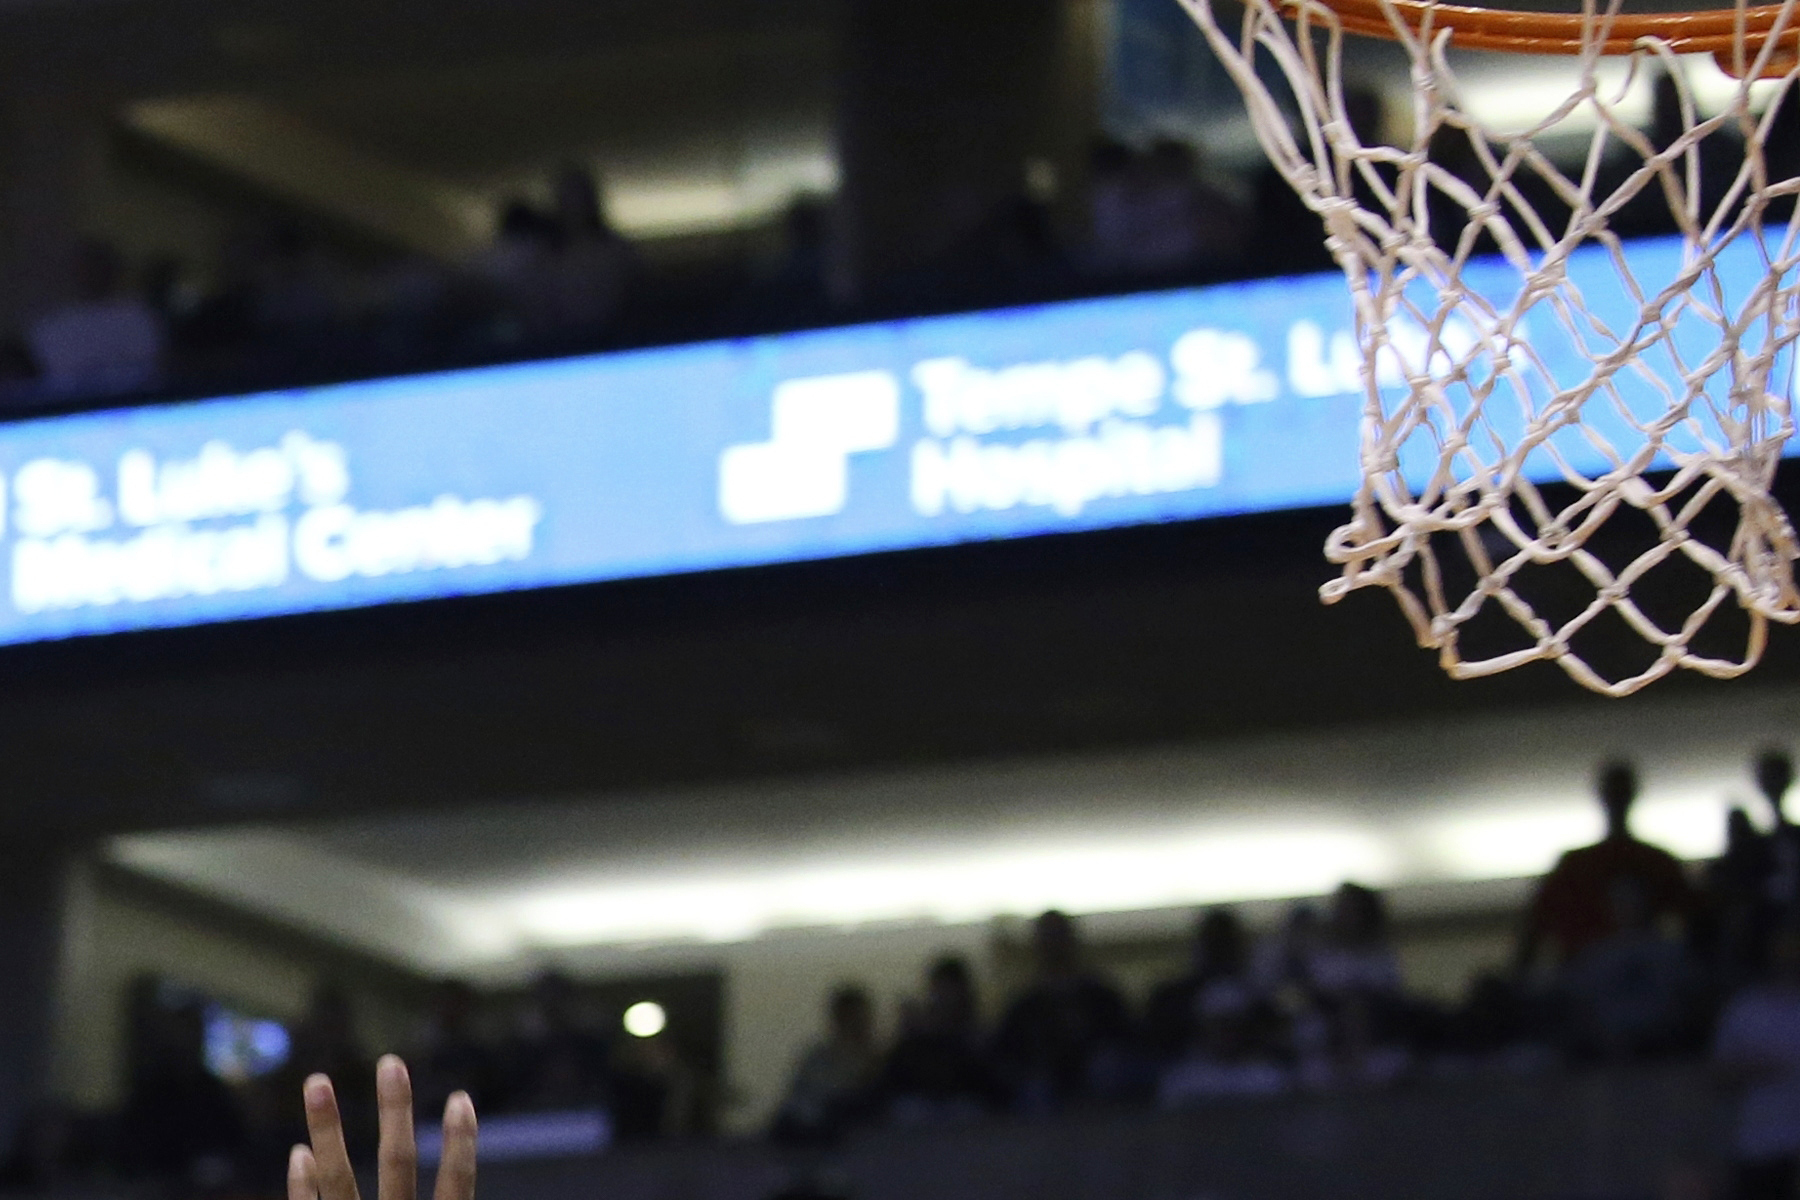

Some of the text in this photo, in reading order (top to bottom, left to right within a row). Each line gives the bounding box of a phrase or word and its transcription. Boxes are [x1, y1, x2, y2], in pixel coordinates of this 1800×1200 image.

[119, 430, 349, 526] Luke's
[911, 412, 1221, 513] Hospital
[294, 496, 538, 581] Center
